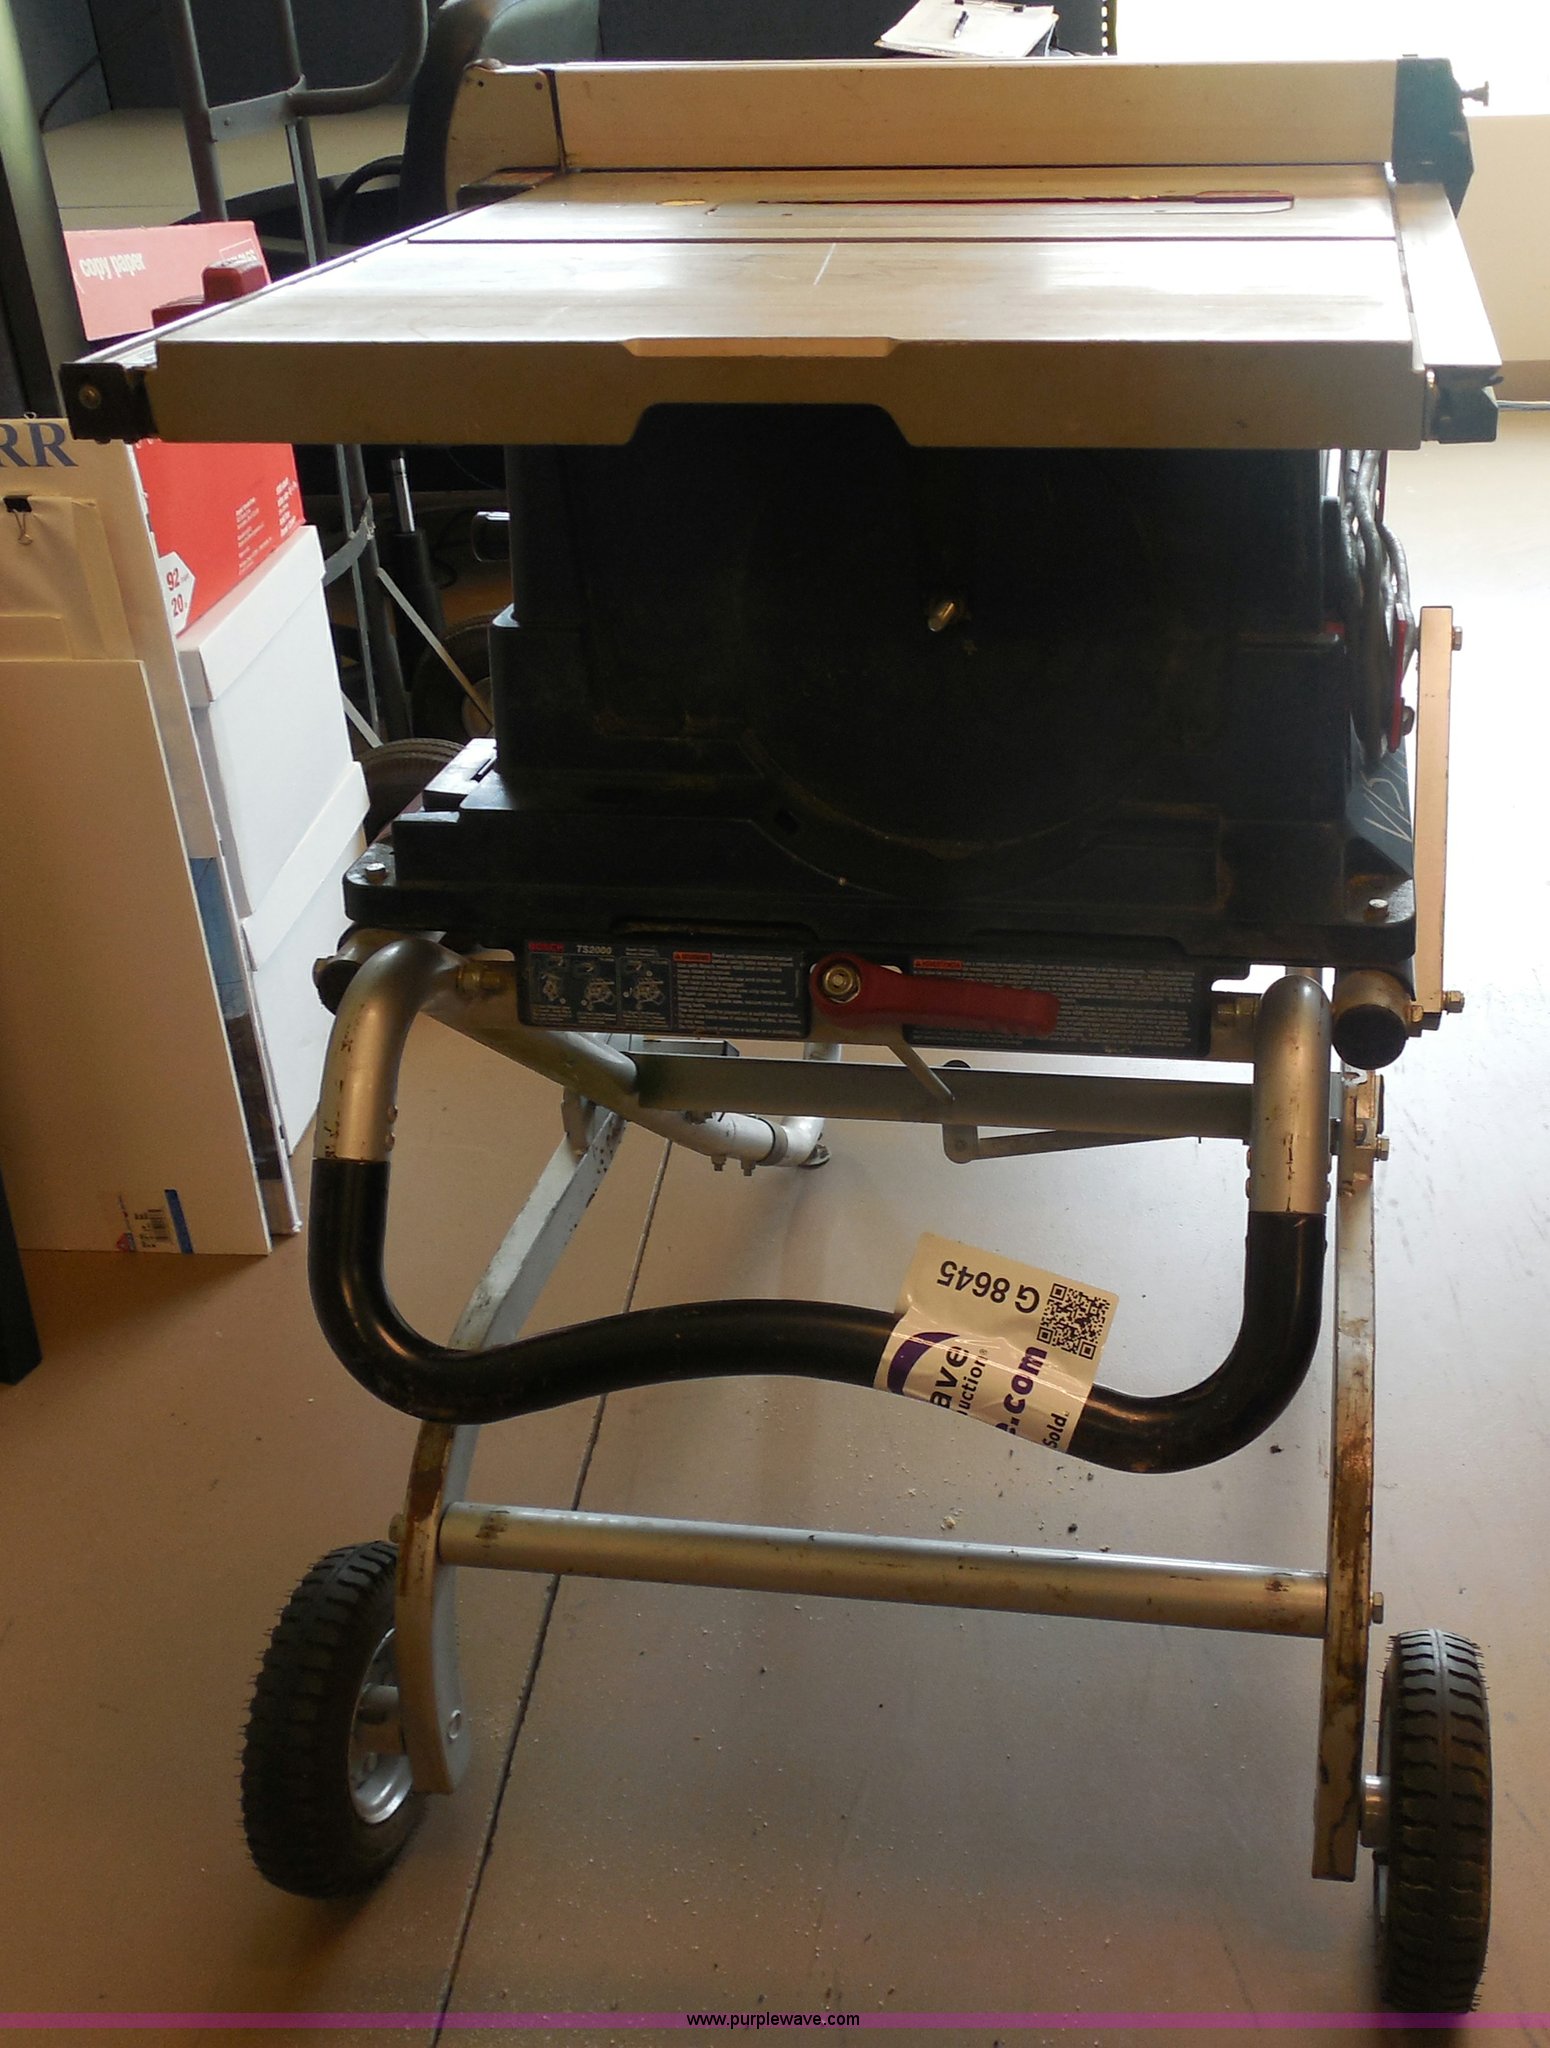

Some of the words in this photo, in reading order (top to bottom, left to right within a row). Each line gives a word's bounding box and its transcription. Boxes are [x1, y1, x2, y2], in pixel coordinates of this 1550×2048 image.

[78, 256, 113, 281] copy
[110, 252, 146, 278] paper
[166, 567, 180, 591] 92
[171, 593, 184, 617] 20
[936, 1260, 1010, 1303] 8645
[1014, 1284, 1040, 1313] G
